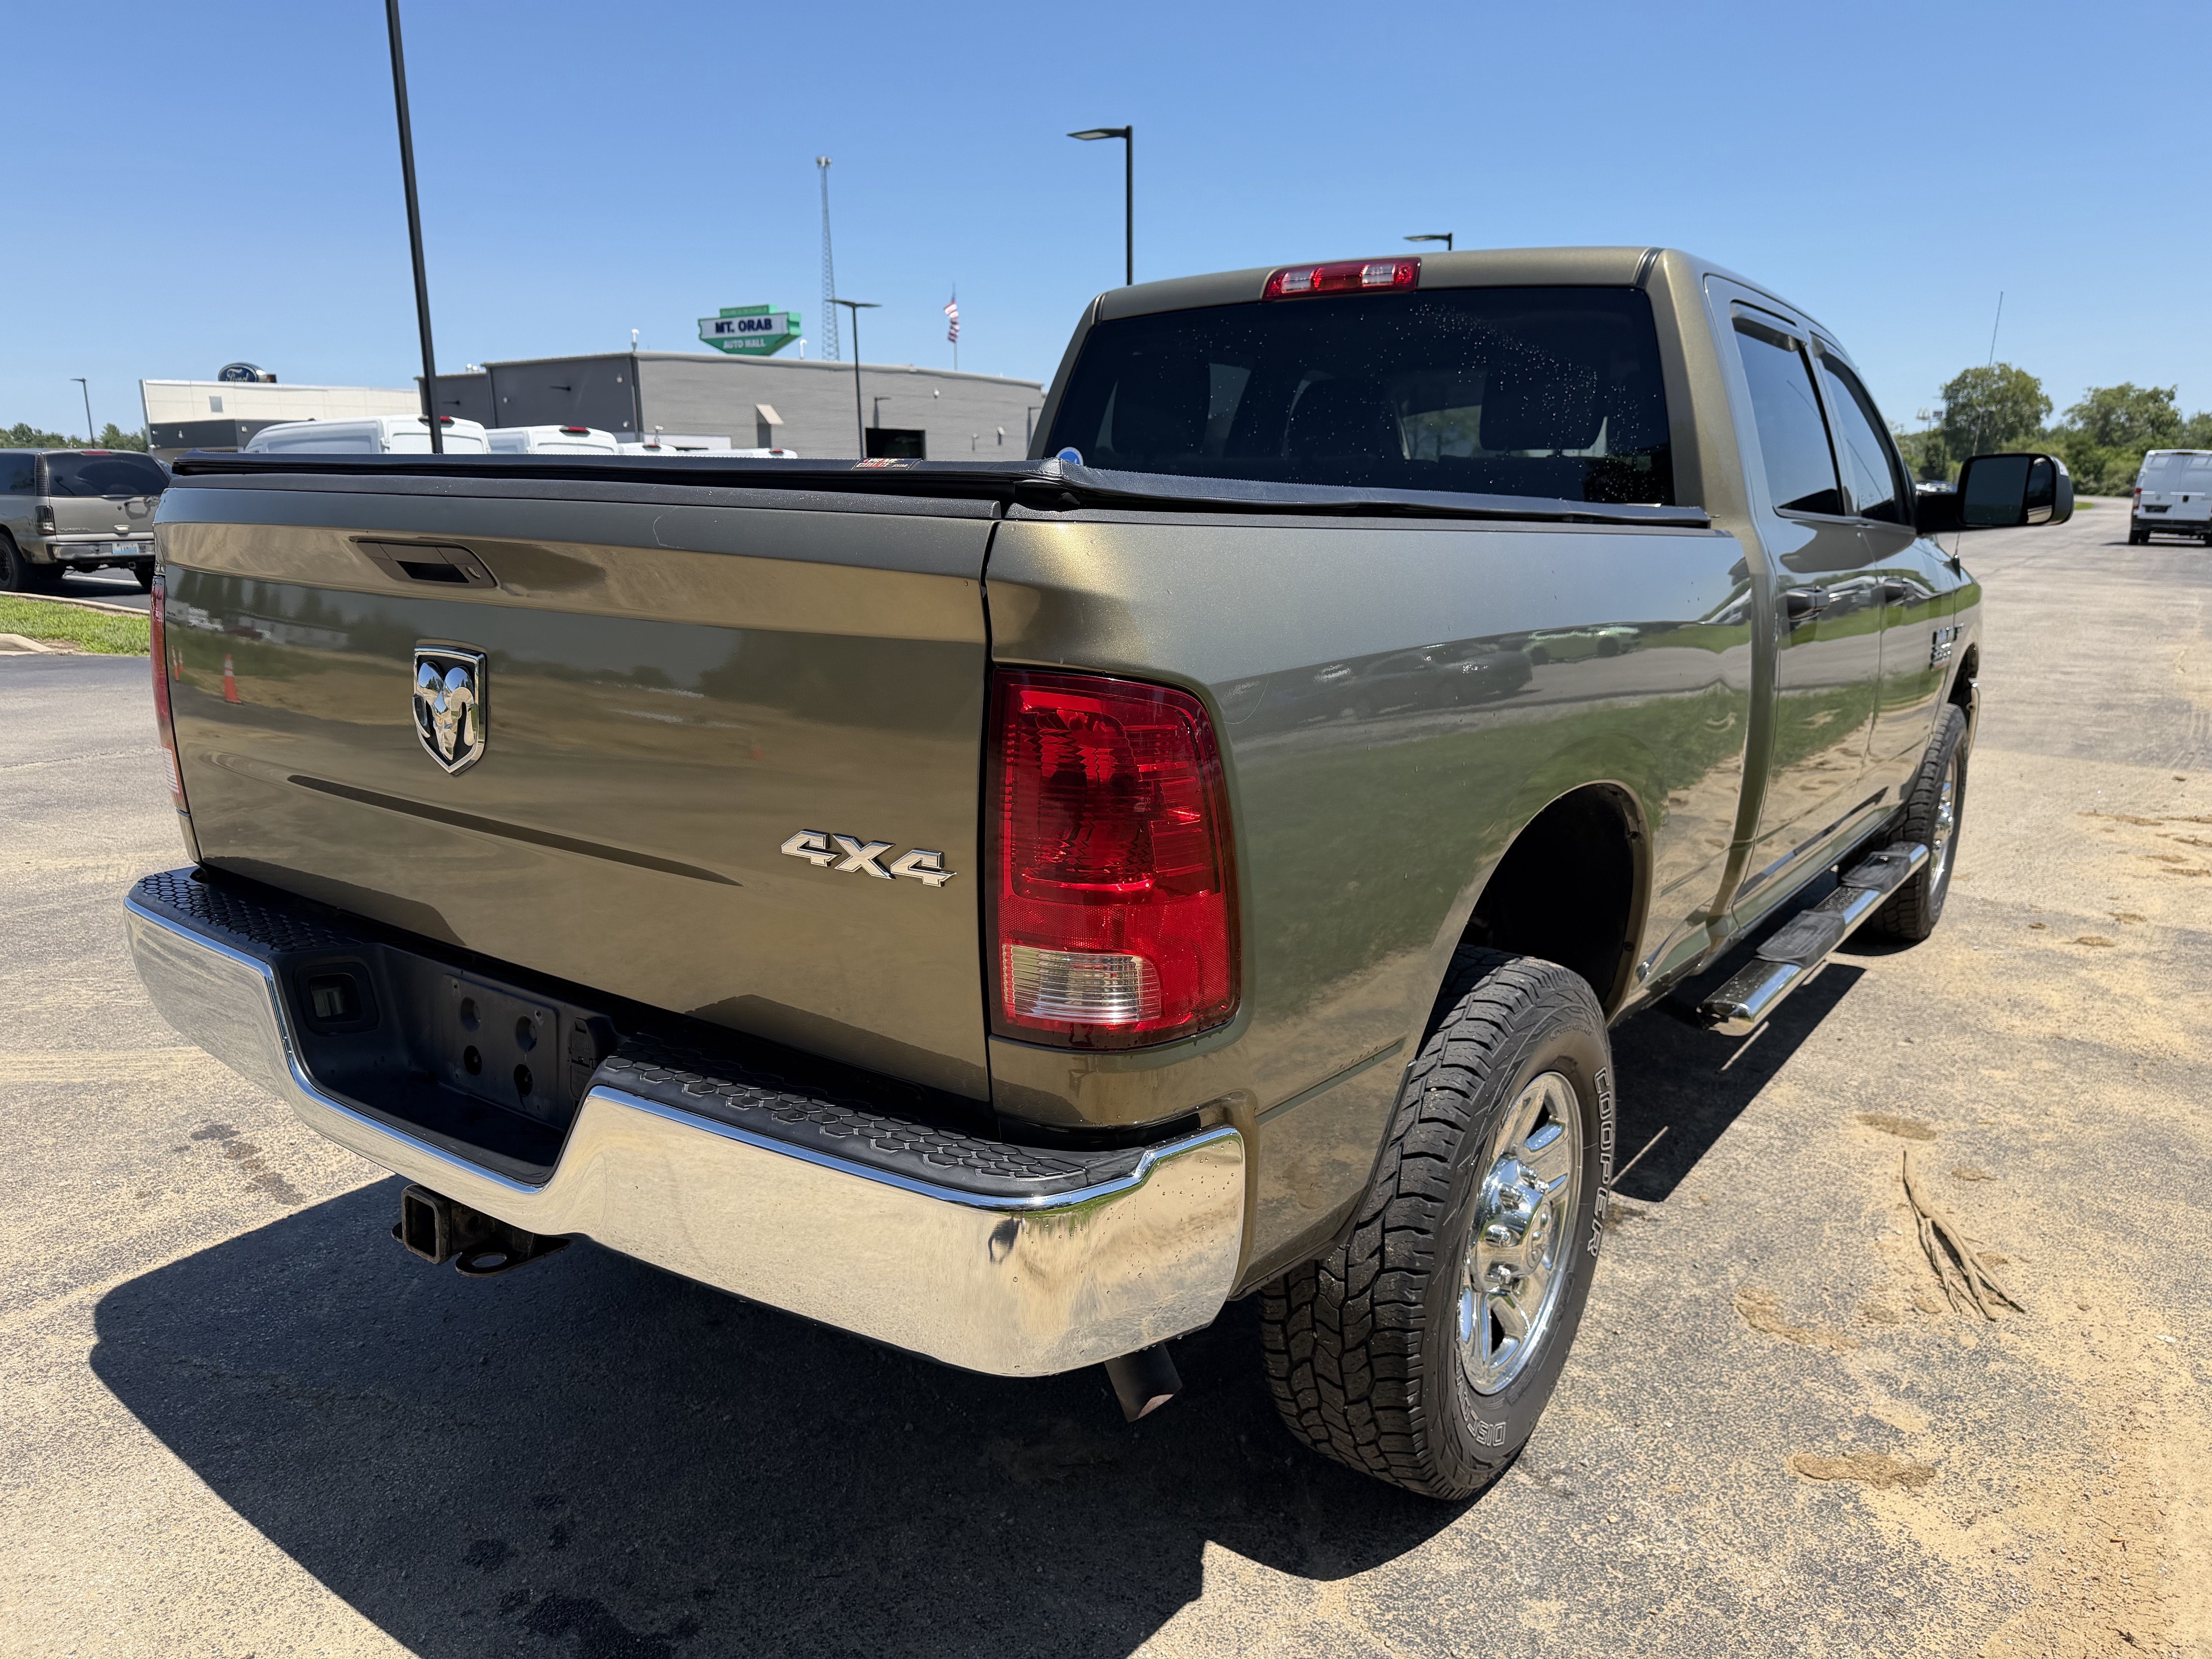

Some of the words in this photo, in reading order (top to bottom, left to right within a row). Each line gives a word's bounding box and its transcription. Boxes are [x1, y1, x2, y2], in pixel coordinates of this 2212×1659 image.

[715, 321, 735, 334] MT.
[738, 318, 772, 332] ORAB
[723, 339, 744, 349] AUTO
[1587, 1067, 1612, 1257] COOPER
